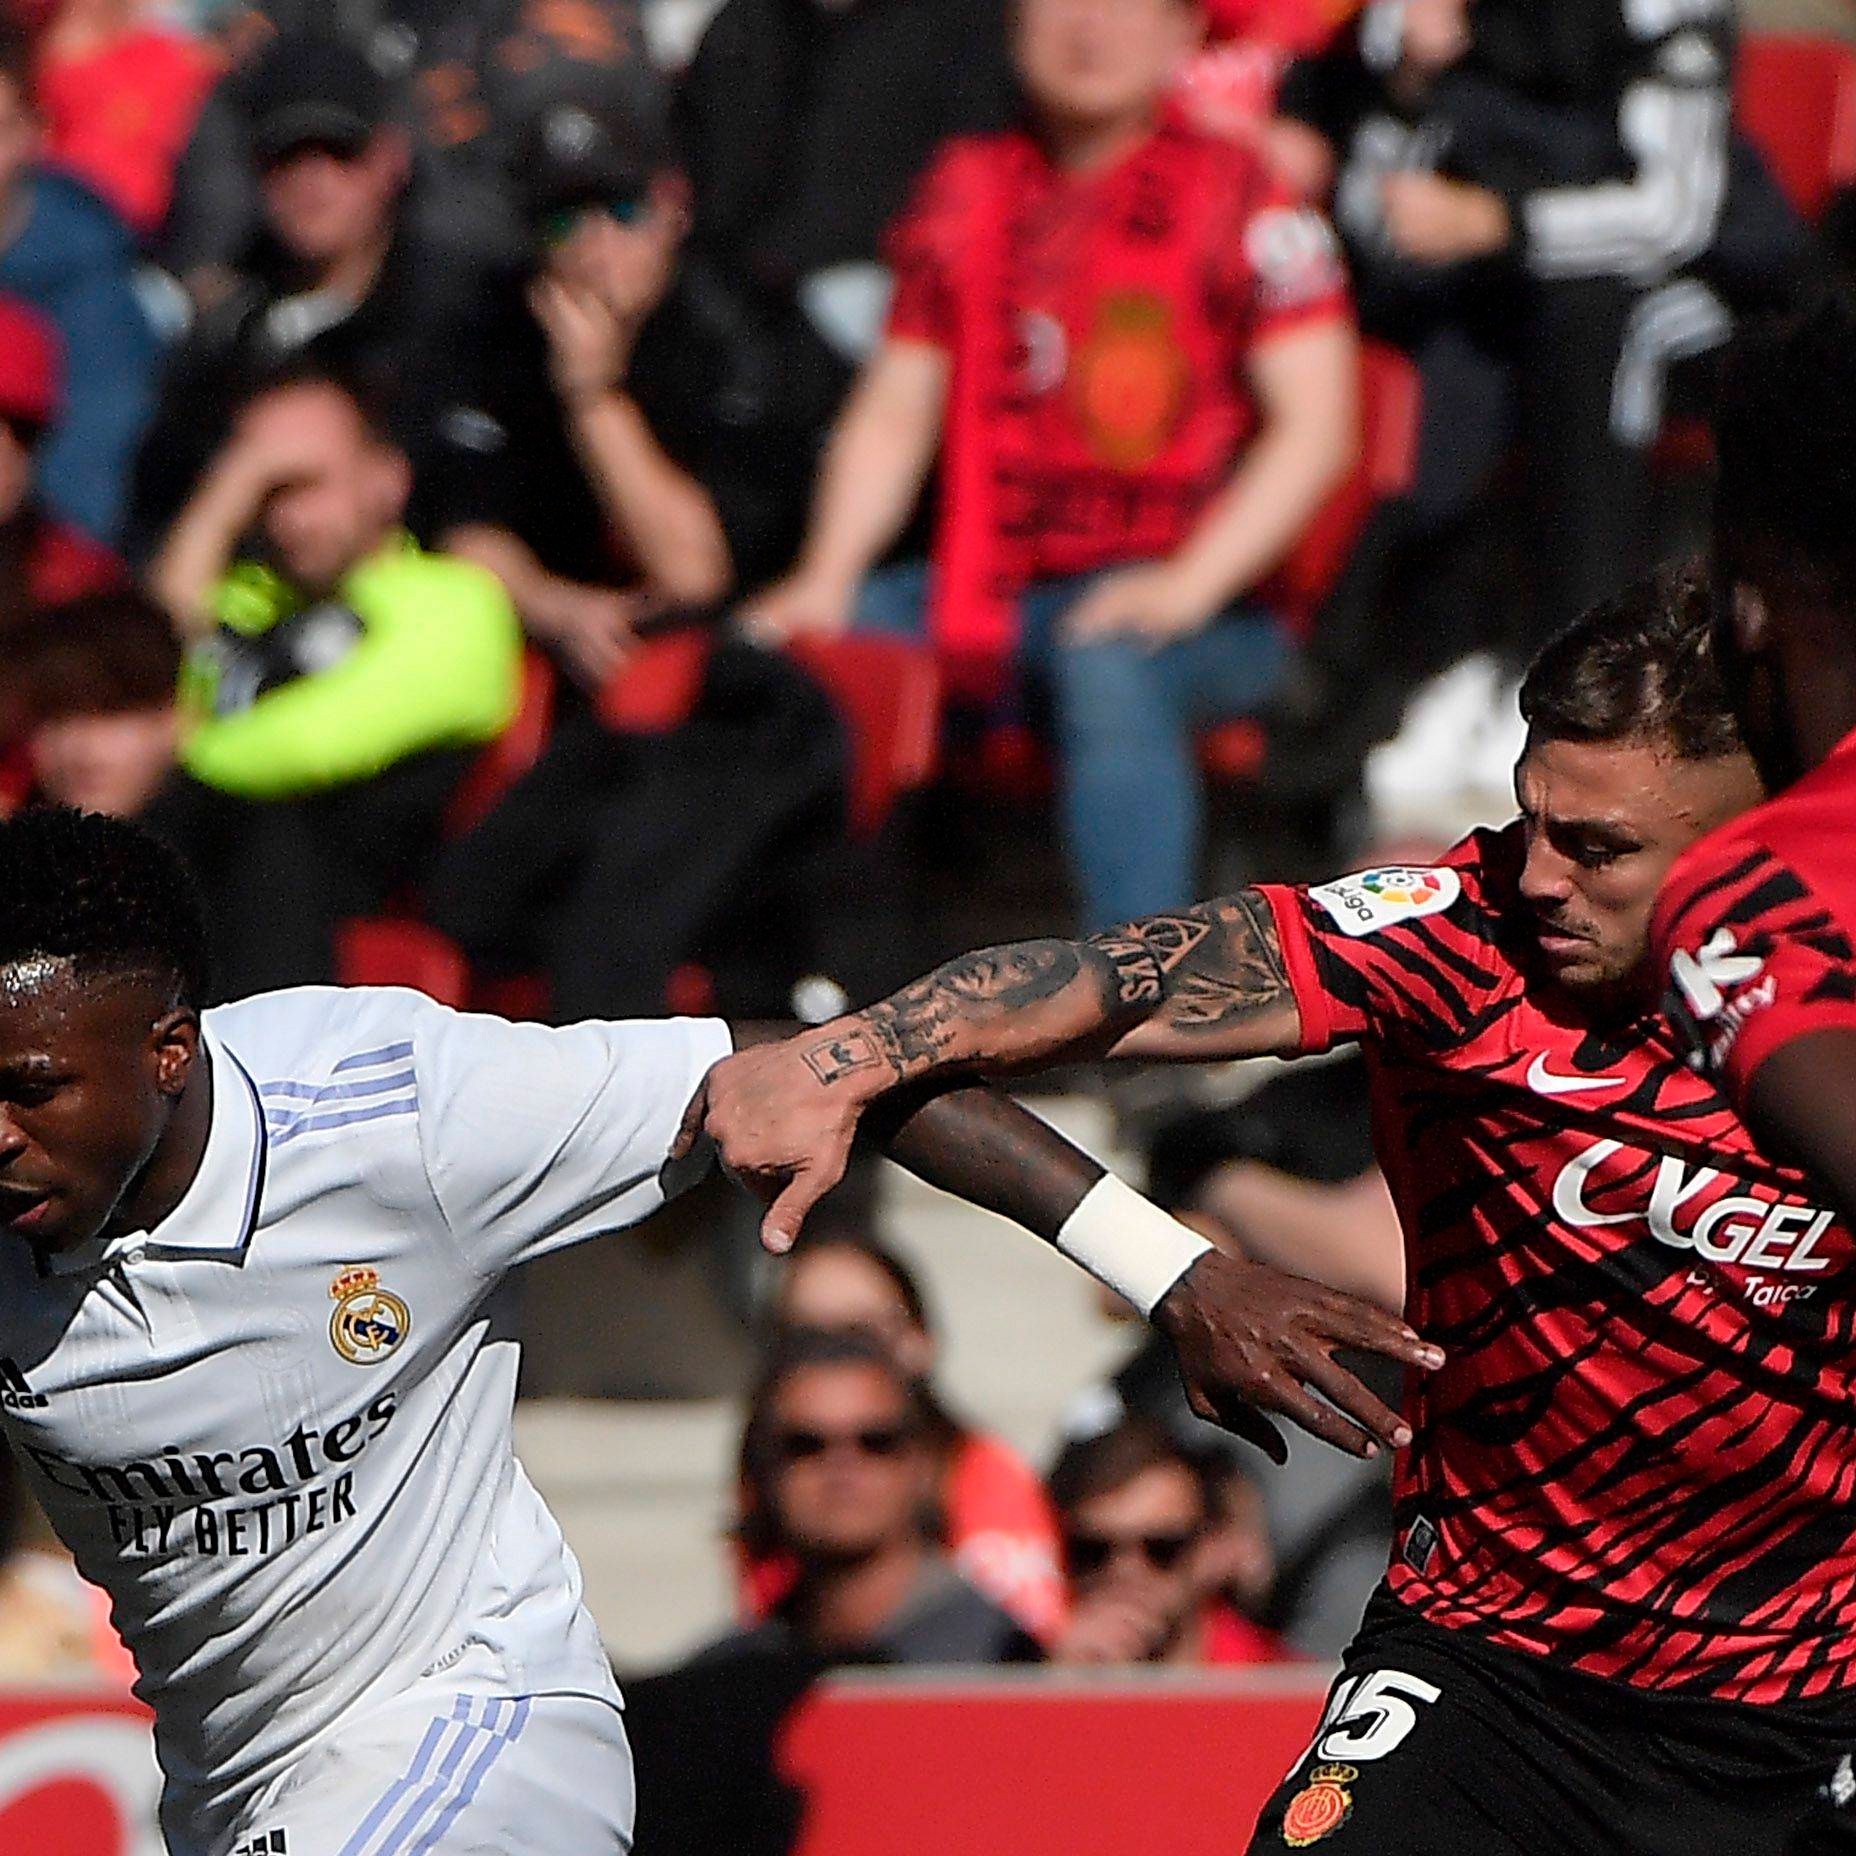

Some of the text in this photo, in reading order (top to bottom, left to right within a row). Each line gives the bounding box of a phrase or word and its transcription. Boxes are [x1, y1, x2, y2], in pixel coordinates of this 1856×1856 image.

[1743, 1275, 1818, 1307] Taica
[23, 1391, 396, 1503] Emirates
[108, 1470, 357, 1556] FLY BETTER
